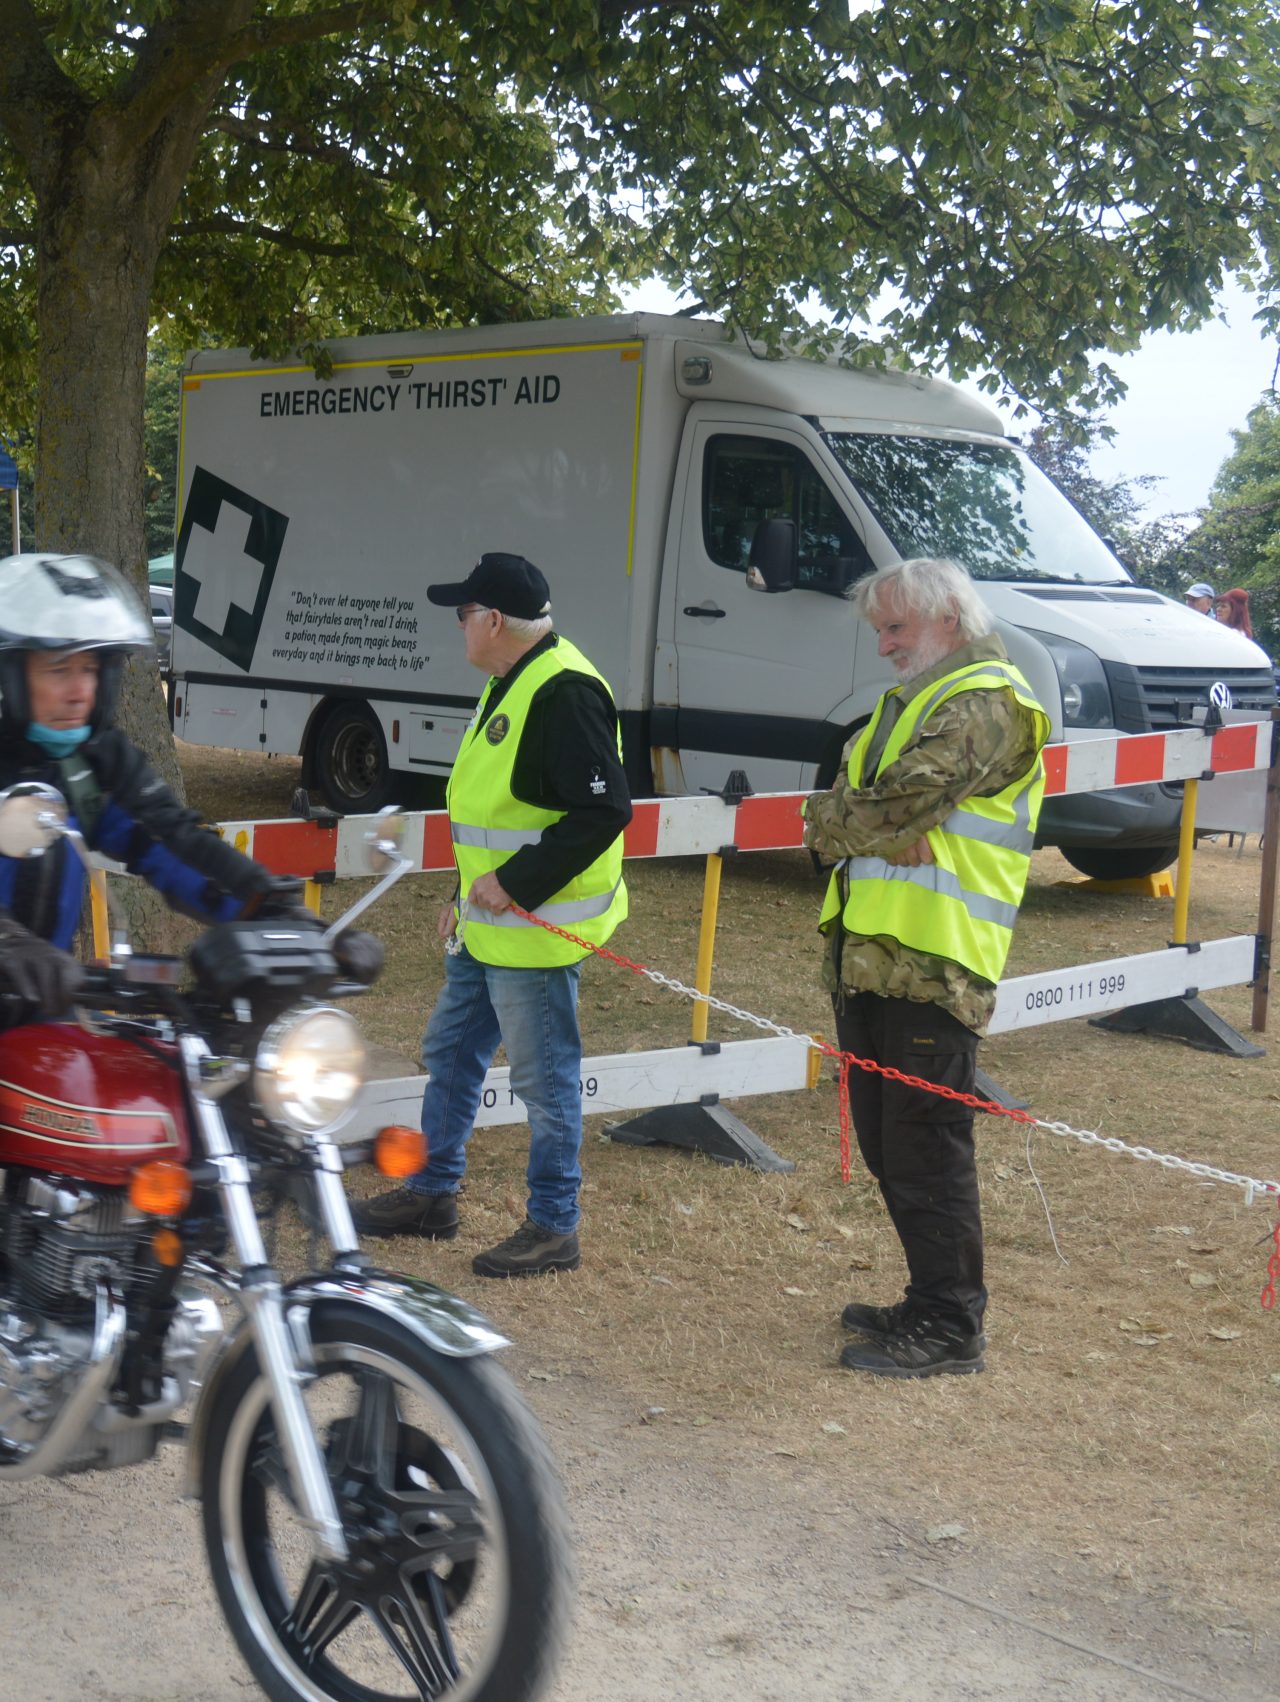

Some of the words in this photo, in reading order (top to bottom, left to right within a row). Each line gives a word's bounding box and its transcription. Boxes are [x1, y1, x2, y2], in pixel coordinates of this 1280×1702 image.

[260, 384, 401, 417] EMERGENCY
[408, 378, 507, 410] 'THIRST'
[514, 375, 561, 405] AID
[291, 591, 317, 608] "Don't
[319, 597, 335, 606] ever
[337, 594, 349, 607] let
[350, 598, 380, 612] anyone
[383, 597, 396, 609] tell
[397, 601, 414, 613] you
[286, 610, 303, 625] that
[303, 611, 342, 627] fairytales
[344, 613, 369, 629] aren't
[370, 616, 387, 628] real
[388, 615, 394, 629] I
[395, 617, 418, 633] drink
[284, 631, 290, 640] a
[291, 630, 316, 645] potion
[318, 632, 341, 645] made
[341, 632, 362, 648] from
[364, 635, 390, 650] magic
[391, 636, 417, 652] beans
[272, 648, 308, 661] everyday
[309, 650, 325, 663] and
[326, 650, 334, 662] it
[334, 651, 361, 666] brings
[362, 655, 375, 668] me
[377, 653, 398, 670] back
[399, 656, 407, 668] to
[409, 656, 430, 671] life"
[1026, 987, 1063, 1010] 0800
[1069, 980, 1092, 1001] 111
[1099, 974, 1125, 995] 999
